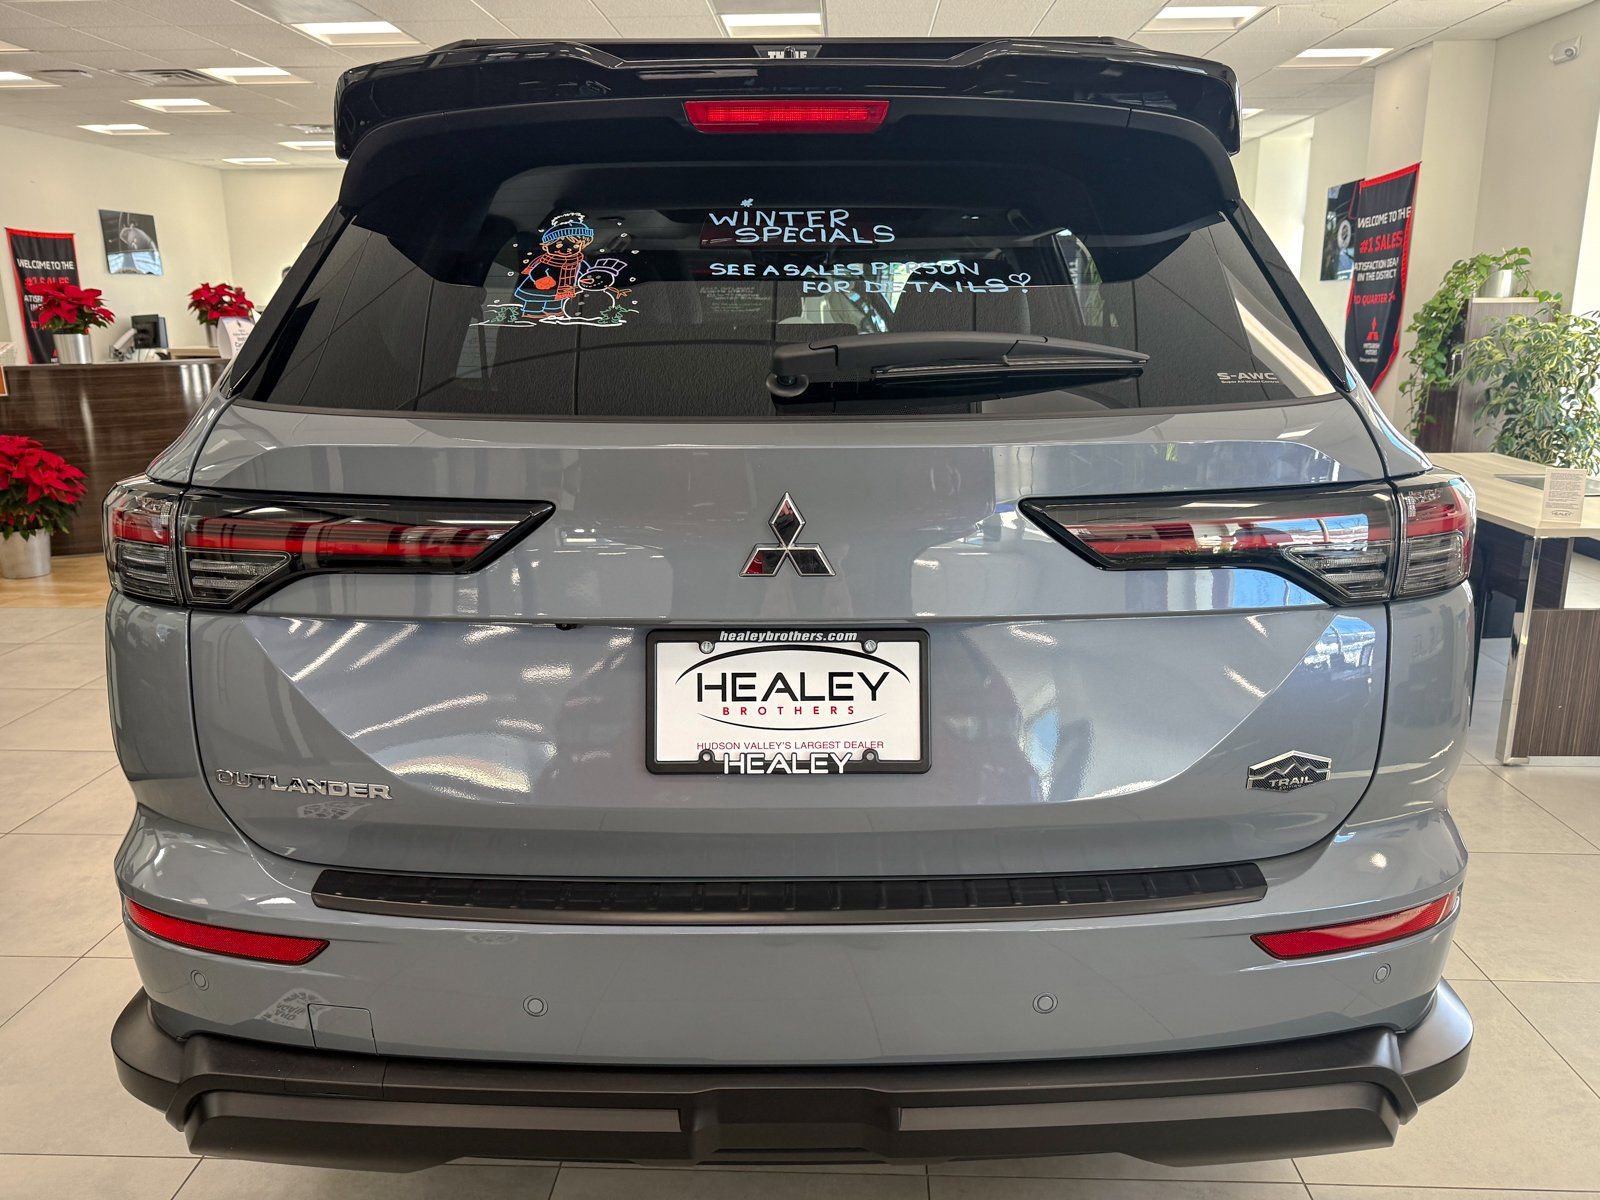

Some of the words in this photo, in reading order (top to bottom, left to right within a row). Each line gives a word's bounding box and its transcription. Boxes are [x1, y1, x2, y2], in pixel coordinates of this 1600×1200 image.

[709, 208, 849, 228] WINTER
[1357, 212, 1388, 228] WELCOME
[1388, 210, 1398, 224] TO
[1397, 206, 1411, 221] THE
[735, 225, 895, 243] SPECIALS
[1360, 236, 1374, 255] #1
[1375, 230, 1403, 251] SALES
[17, 258, 51, 270] WELCOME
[51, 261, 61, 270] TO
[61, 261, 75, 270] THE
[709, 263, 756, 276] SEE
[763, 265, 780, 276] A
[783, 263, 864, 277] SALES
[803, 280, 851, 293] FOR
[1216, 372, 1277, 380] S-AWC
[719, 631, 858, 642] healeybrothers.com
[697, 672, 890, 702] HEALEY
[722, 706, 854, 715] BROTHERS
[697, 742, 741, 750] HUDSON
[744, 741, 791, 750] VALLEY'S
[794, 741, 841, 750] LARGEST
[843, 740, 884, 750] DEALER
[723, 753, 852, 774] HEALEY
[215, 768, 393, 800] OUTLANDER
[1268, 776, 1314, 787] TRAIL
